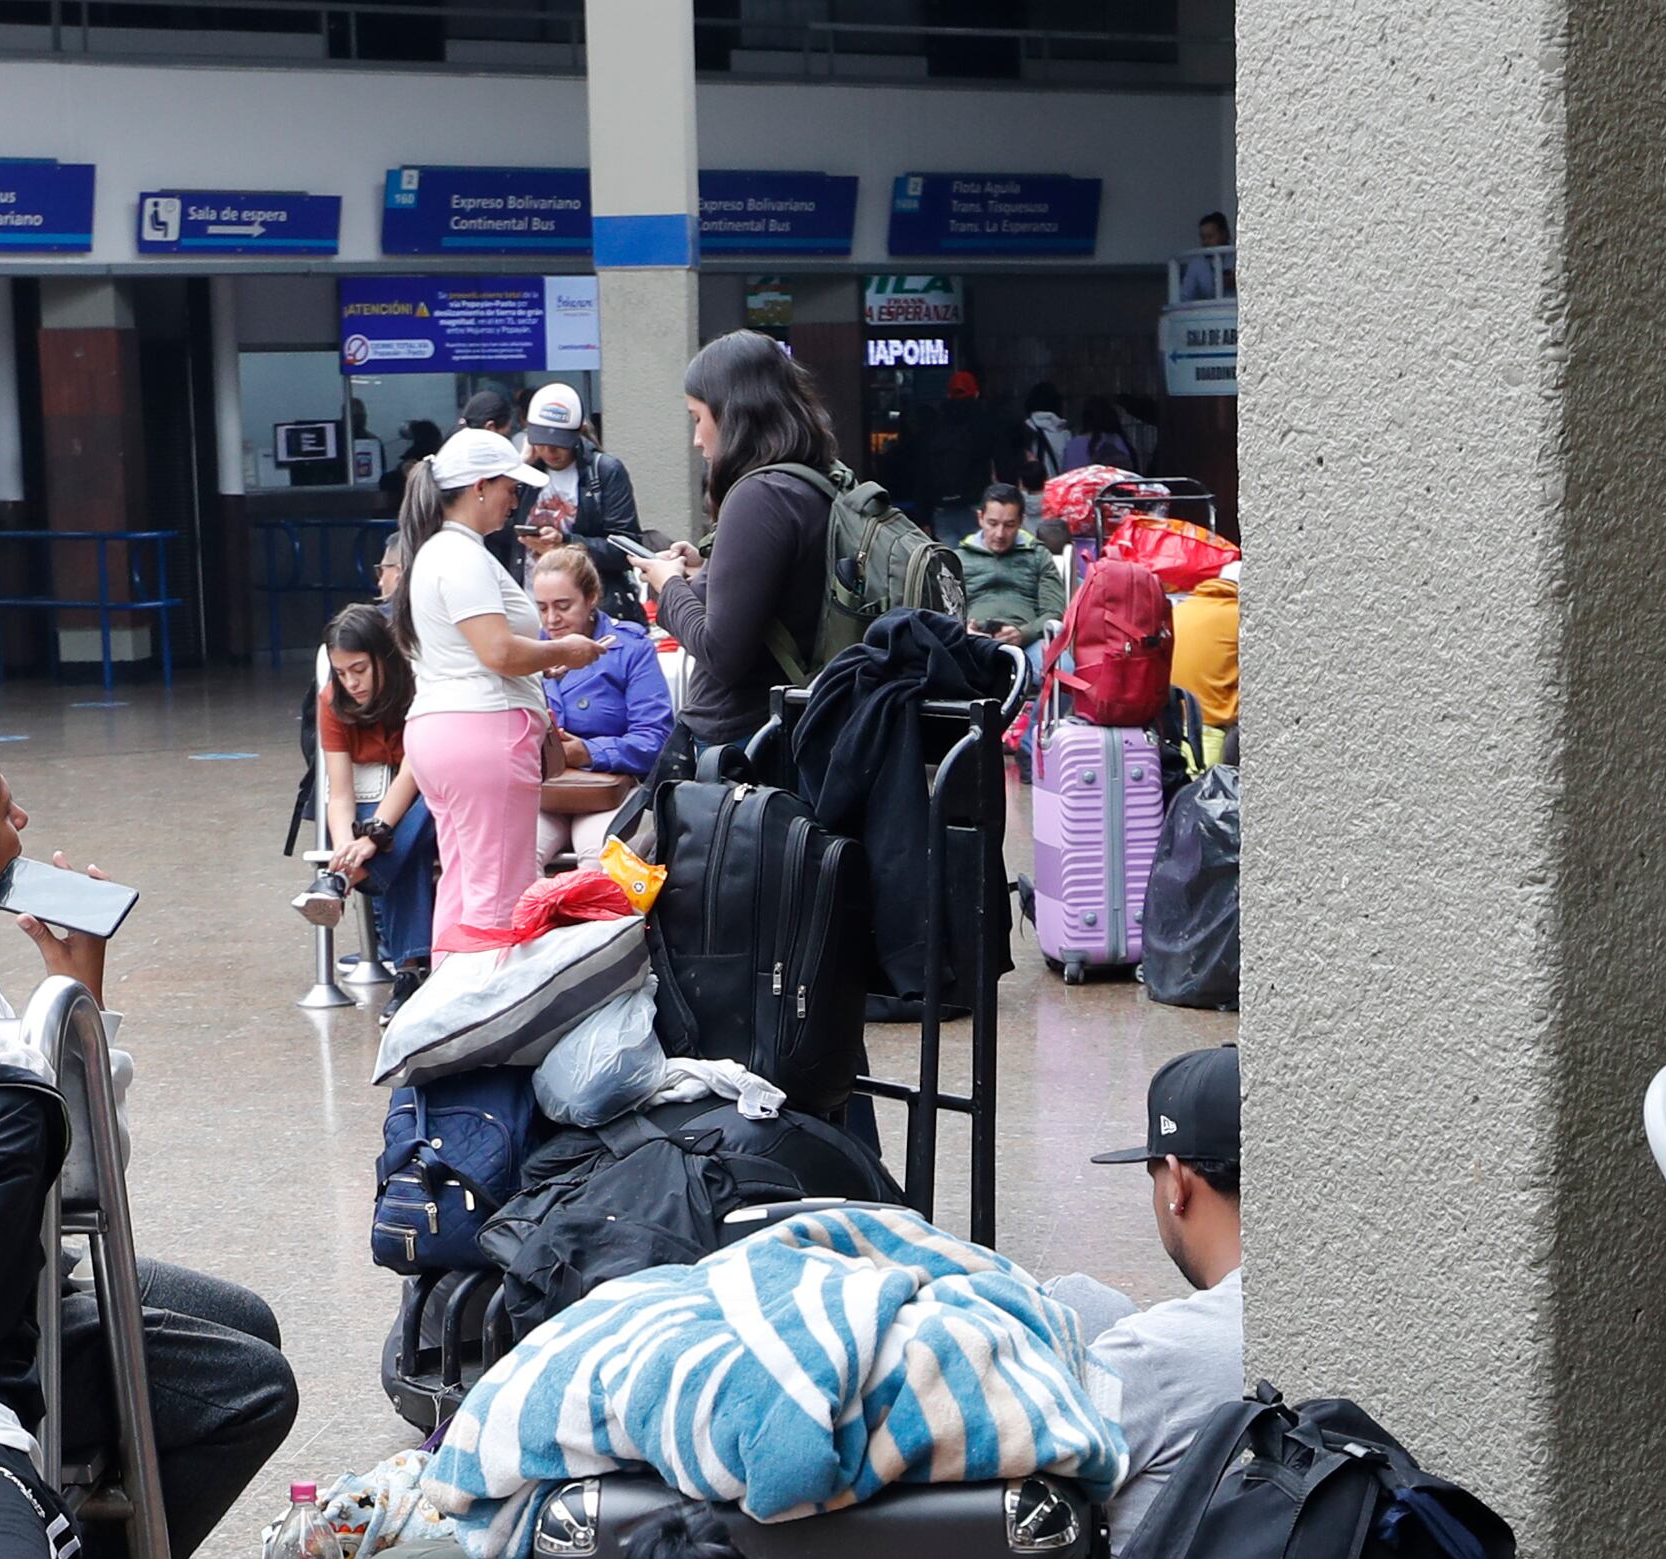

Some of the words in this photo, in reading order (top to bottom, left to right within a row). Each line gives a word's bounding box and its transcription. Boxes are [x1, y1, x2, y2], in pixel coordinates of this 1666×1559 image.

[406, 174, 415, 185] 2
[951, 181, 982, 194] Flota
[450, 195, 505, 212] Expreso
[507, 196, 582, 210] Bolivariano
[746, 198, 816, 212] Bolivariano
[187, 206, 217, 220] Sala
[221, 206, 238, 221] de
[241, 210, 288, 226] espera
[449, 216, 529, 231] Continental
[532, 218, 556, 231] Bus
[699, 217, 766, 232] ontinental
[768, 219, 792, 232] Bus
[985, 220, 999, 233] La
[1001, 220, 1060, 235] Esperanza
[343, 301, 413, 319] ¡ATENCIÓN!
[878, 305, 961, 322] ESPERANZA
